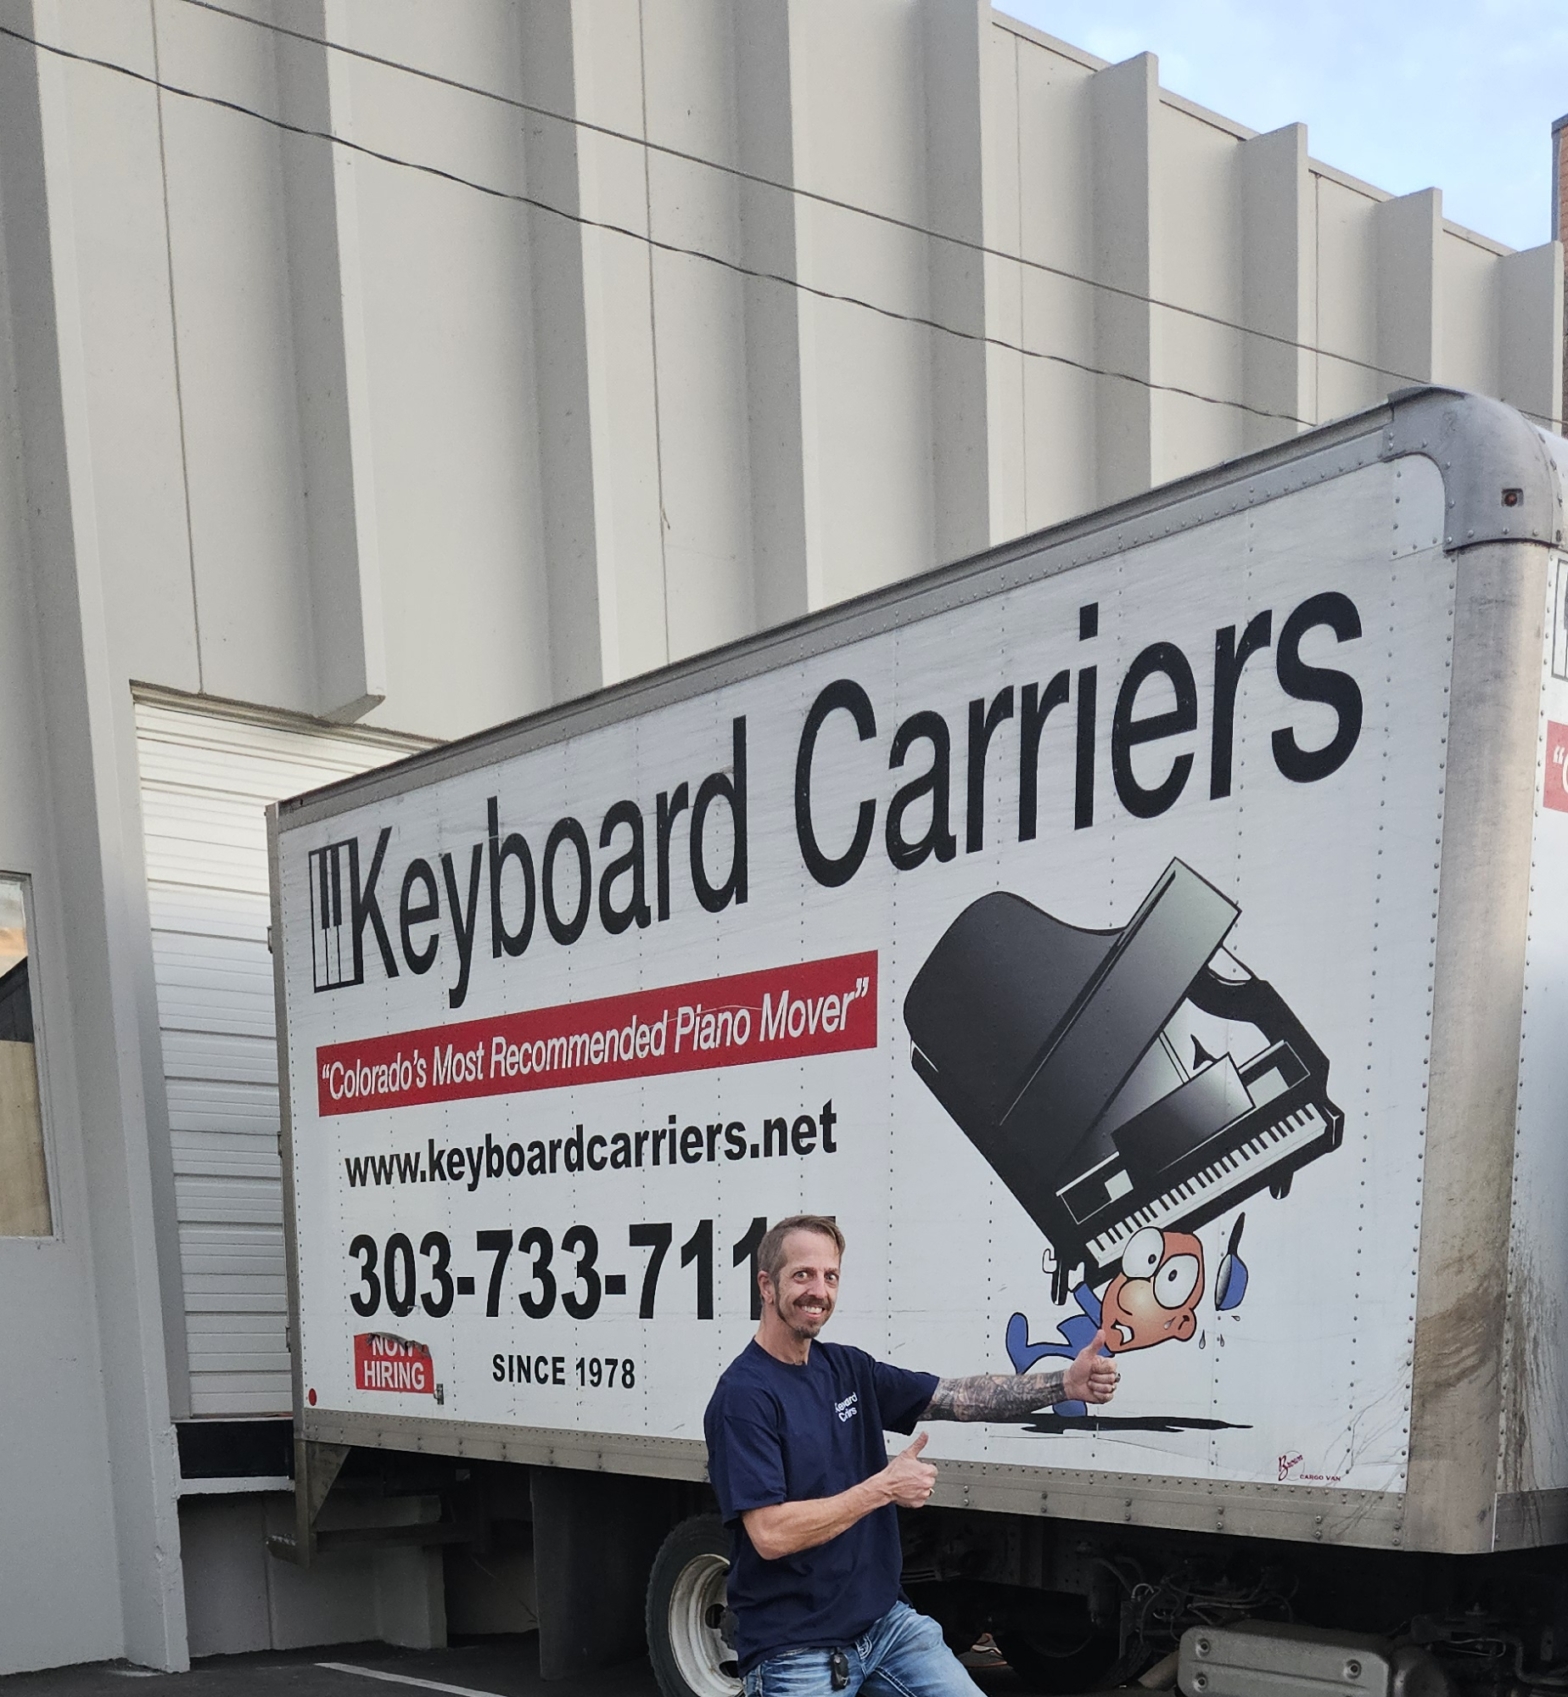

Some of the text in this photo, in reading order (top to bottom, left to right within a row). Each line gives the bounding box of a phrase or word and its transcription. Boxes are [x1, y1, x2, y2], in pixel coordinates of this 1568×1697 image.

[350, 591, 1364, 1010] Keyboard Carriers
[432, 1042, 483, 1087] Most
[490, 1009, 669, 1079] Recommended
[674, 1003, 751, 1053] Piano
[759, 976, 870, 1043] Mover”
[345, 1098, 838, 1192] www.keyboardcarriers.net
[349, 1215, 836, 1320] 303-733-711
[364, 1360, 425, 1390] HIRING
[492, 1353, 636, 1390] SINCE 1978
[1300, 1473, 1324, 1481] CARGO
